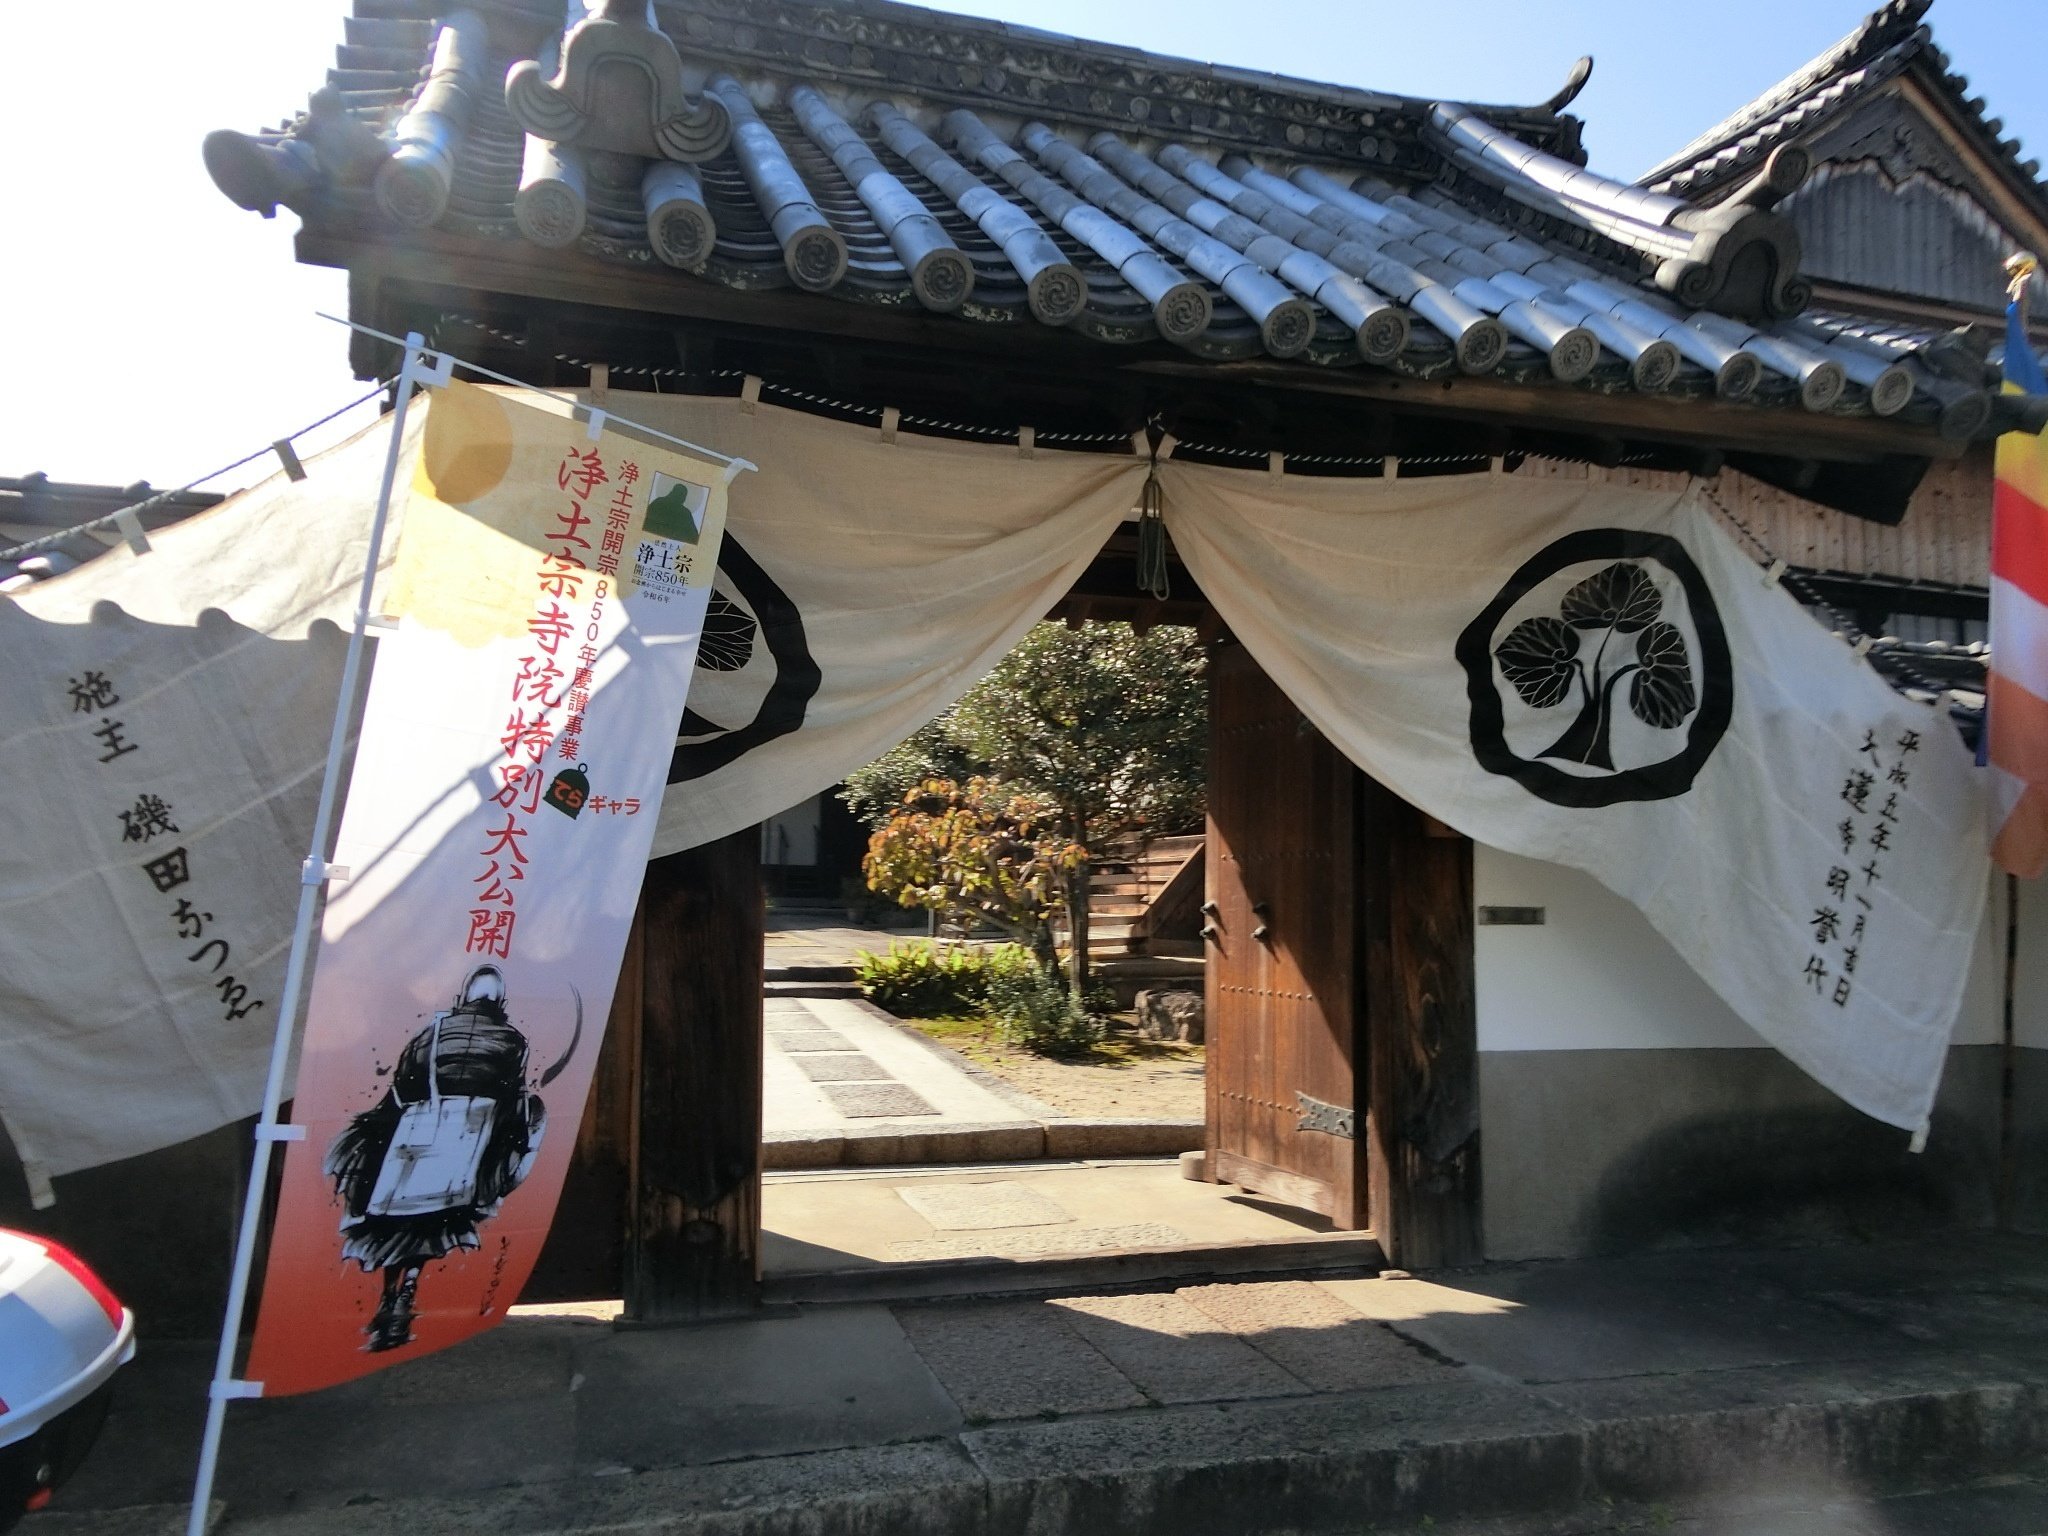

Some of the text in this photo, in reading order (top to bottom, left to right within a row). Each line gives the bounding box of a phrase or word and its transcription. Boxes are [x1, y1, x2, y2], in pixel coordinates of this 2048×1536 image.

[634, 564, 689, 586] 開宗850年
[637, 543, 693, 573] 浄土宗
[67, 671, 139, 764] 施主
[465, 446, 609, 959] 浄土宗寺院特別大公開
[589, 795, 640, 815] ギャラ
[1833, 729, 1922, 1008] 平成五年十一月吉日
